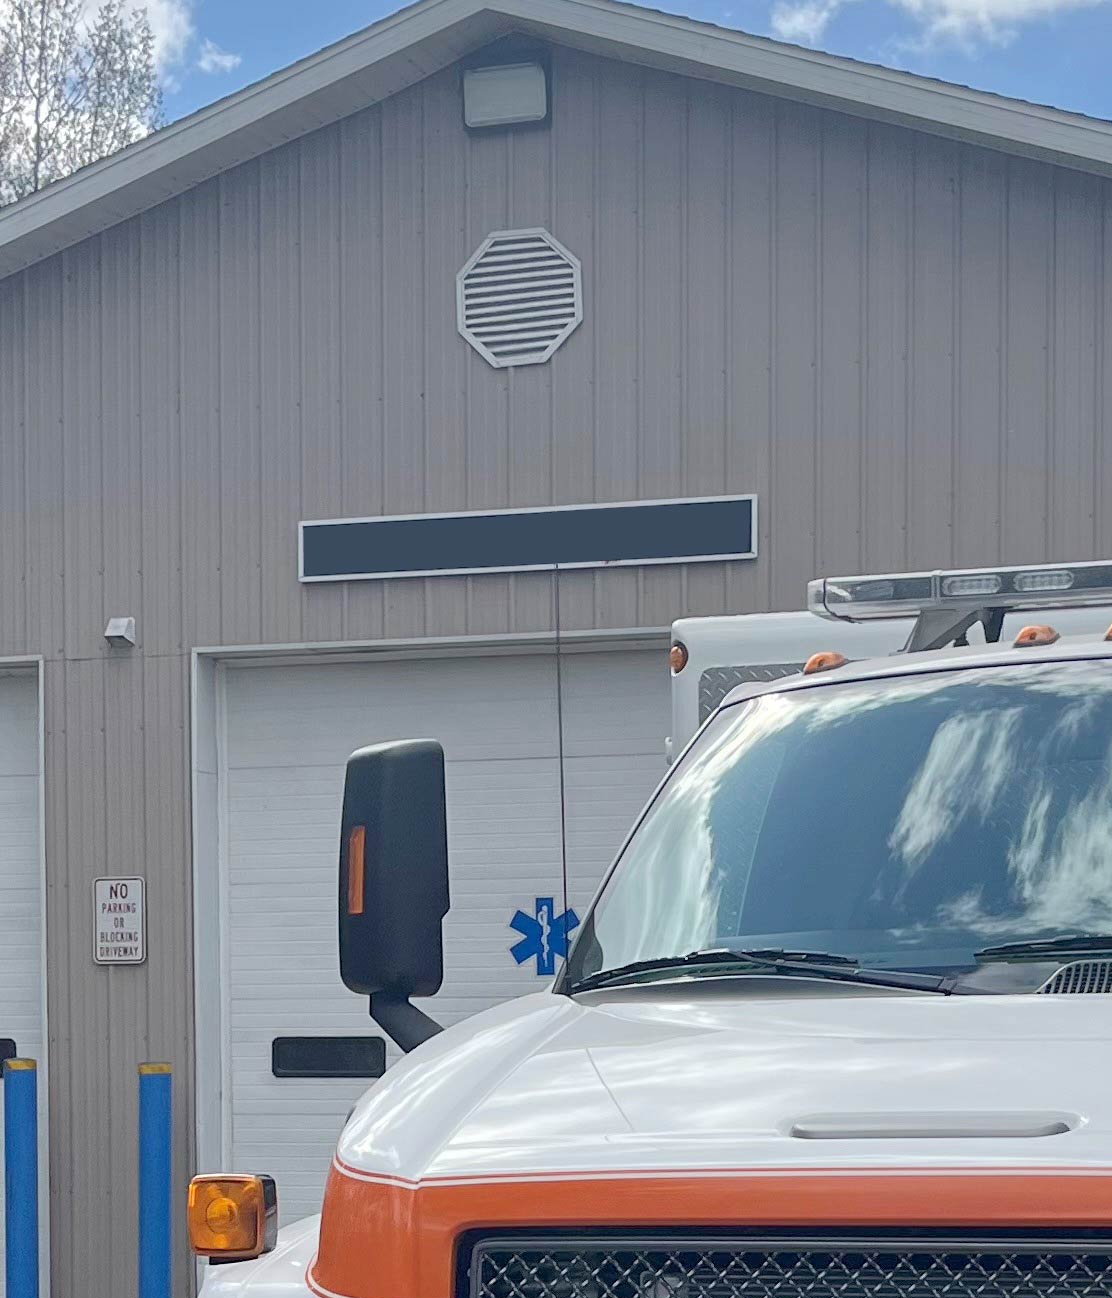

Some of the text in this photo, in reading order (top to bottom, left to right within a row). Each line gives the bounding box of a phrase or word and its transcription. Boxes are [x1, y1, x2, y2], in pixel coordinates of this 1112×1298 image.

[109, 883, 128, 899] NO
[101, 903, 137, 913] PARKING
[113, 917, 125, 928] OR
[100, 932, 138, 943] BLOCKING
[99, 947, 139, 957] DRIVEWAY
